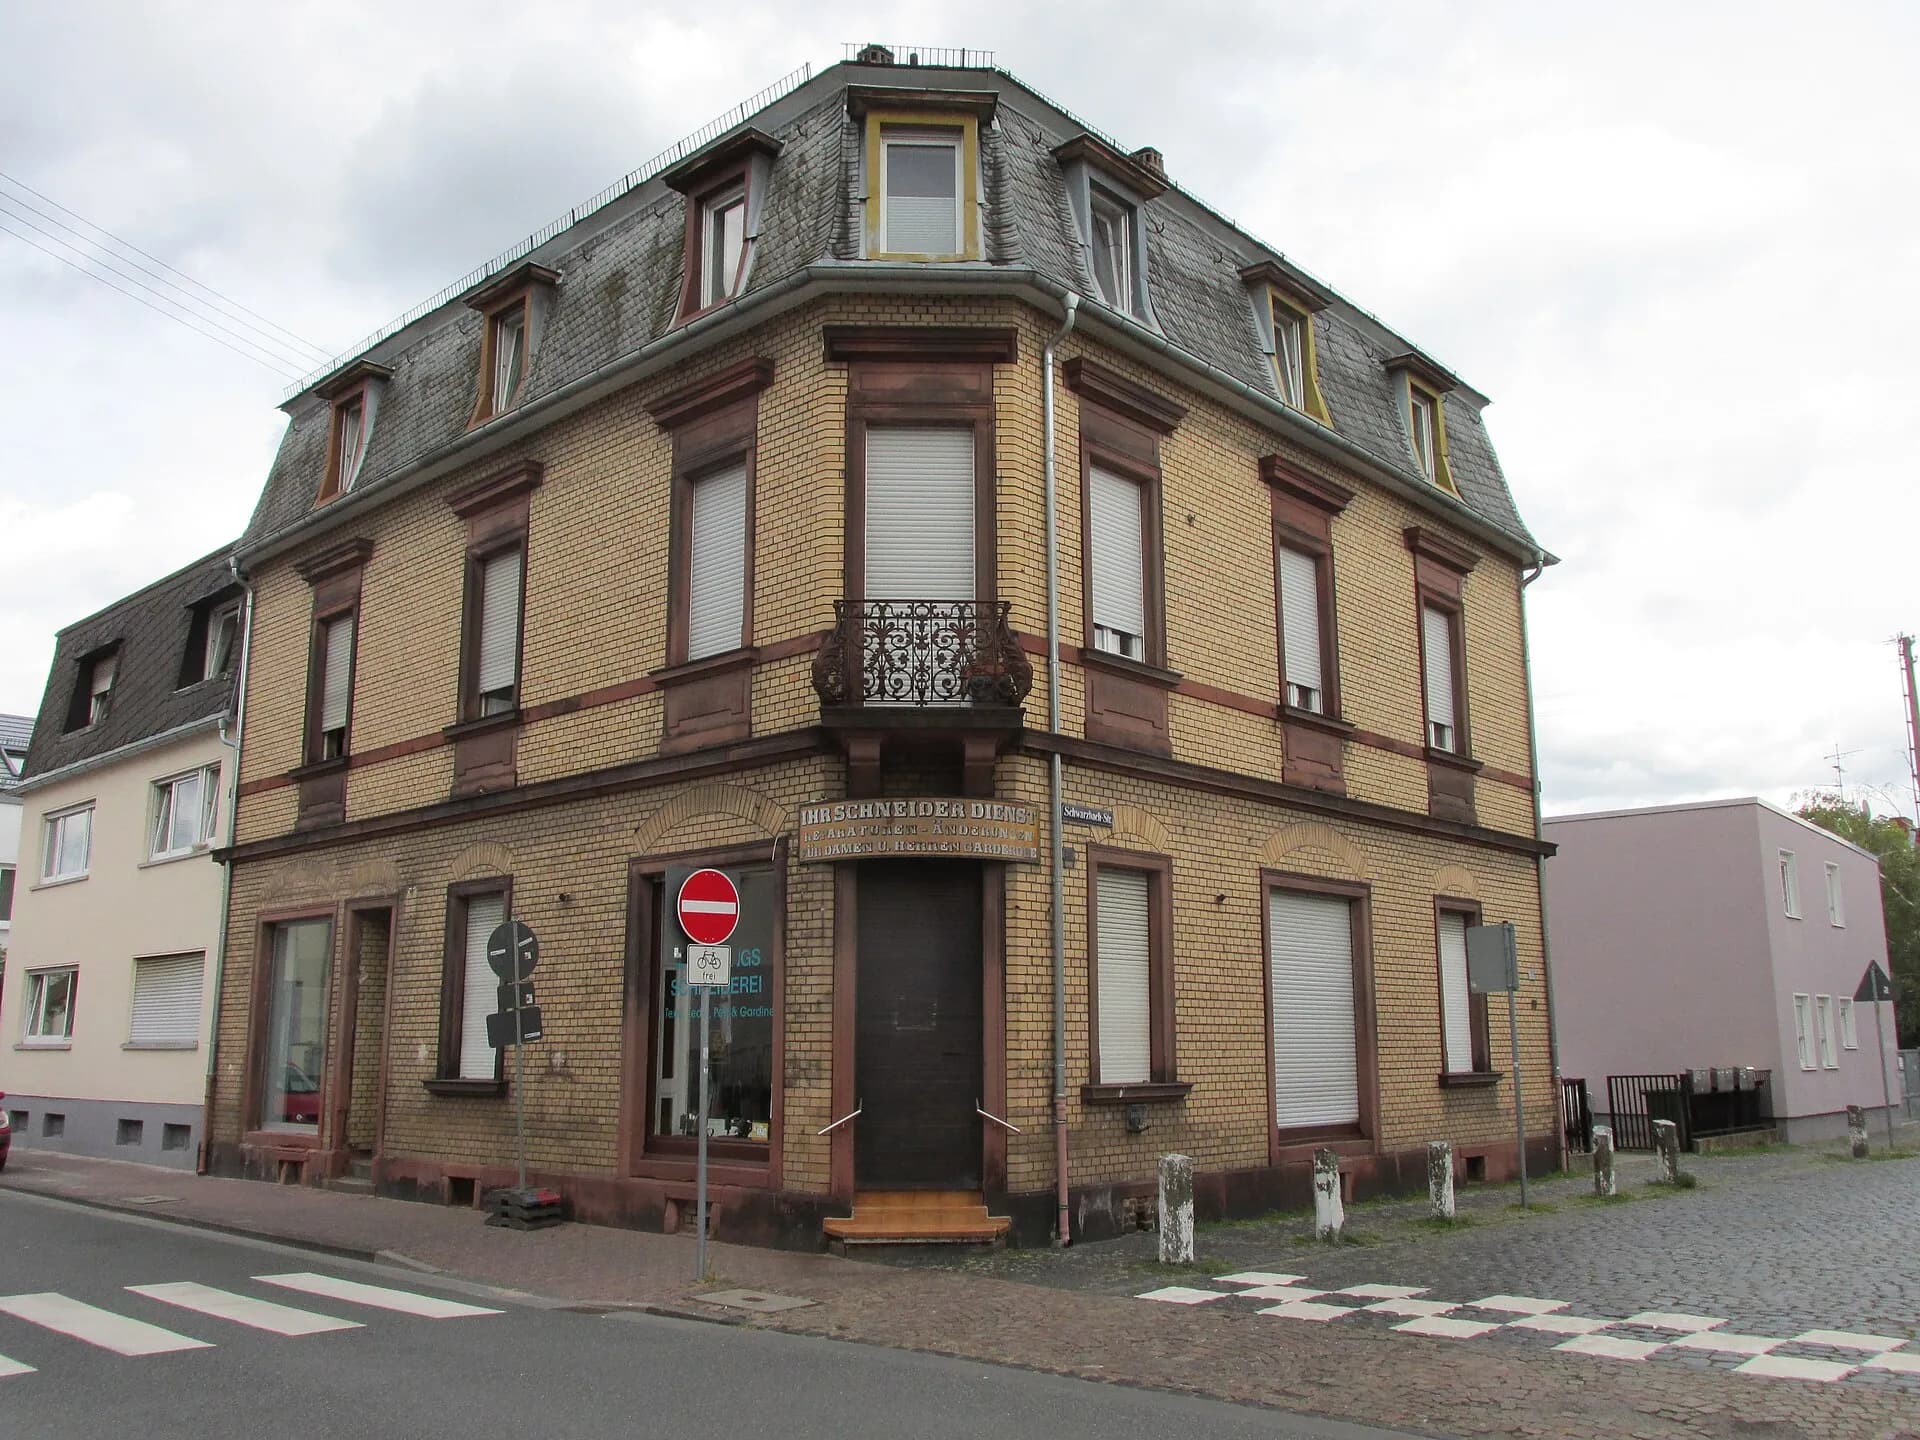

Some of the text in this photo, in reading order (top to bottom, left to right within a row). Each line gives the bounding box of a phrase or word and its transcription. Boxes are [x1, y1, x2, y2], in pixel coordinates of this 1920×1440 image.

[801, 800, 1037, 826] IHR SCHNEIDER DIENST
[825, 842, 873, 856] DAMEN
[702, 972, 716, 981] frei
